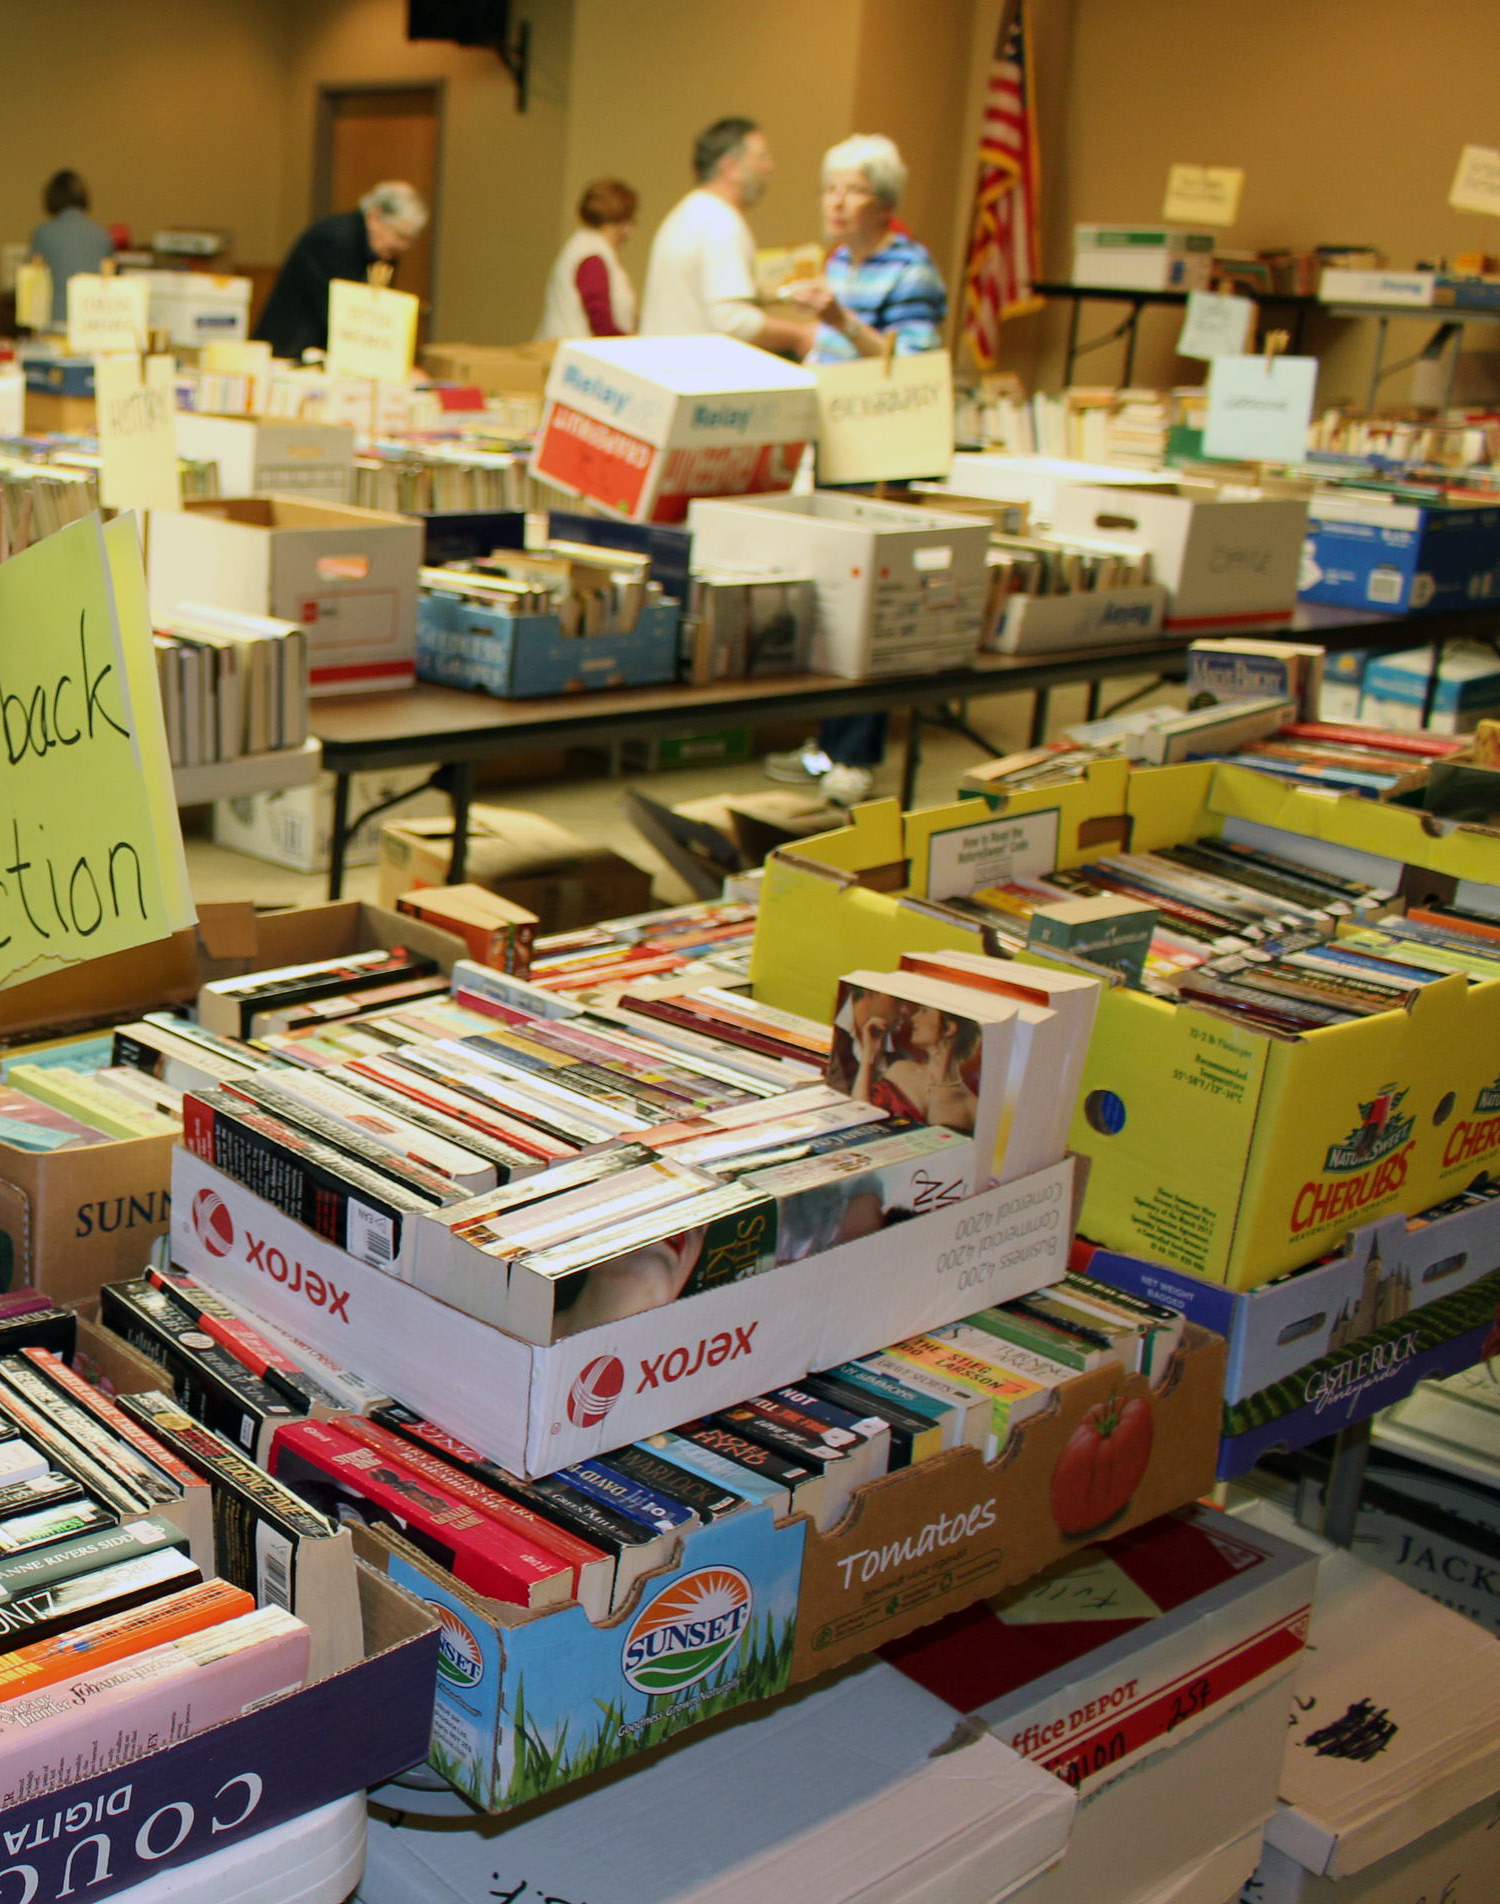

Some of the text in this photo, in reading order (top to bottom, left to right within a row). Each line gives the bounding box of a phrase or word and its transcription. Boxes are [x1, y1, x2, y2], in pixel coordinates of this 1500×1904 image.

[995, 1181, 1063, 1221] Comercial
[1290, 1140, 1417, 1234] CHERUBS
[936, 1208, 1060, 1274] Commercial 4200
[955, 1212, 994, 1242] 4200
[244, 1231, 350, 1325] xerox
[957, 1235, 1058, 1293] Business 4200
[1140, 1274, 1159, 1290] NET
[1159, 1279, 1196, 1302] WEIGHT
[1146, 1288, 1186, 1311] BAGGED
[200, 1351, 266, 1402] DEADLY SIN
[635, 1320, 759, 1395] xerox
[877, 1359, 953, 1393] GRAVE SECRETS
[913, 1338, 991, 1376] THE STIEG
[935, 1359, 1004, 1391] LARSSON
[1304, 1329, 1422, 1403] CASTLE ROCK
[777, 1387, 819, 1407] NOT
[857, 1372, 919, 1402] SIMMONS
[692, 1430, 766, 1467] HYND
[709, 1429, 771, 1458] NOEL
[754, 1418, 808, 1443] LOVE ME
[390, 1436, 538, 1523] MARY HIGGINS CLARK
[400, 1451, 505, 1512] REMEMBER ME
[578, 1468, 629, 1497] DAVID
[619, 1450, 717, 1501] WARLOCK
[44, 1542, 99, 1568] RIVERS
[836, 1498, 997, 1590] Tomatoes
[624, 1602, 749, 1673] SUNSET
[71, 1669, 133, 1706] Johanna
[1067, 1678, 1140, 1733] DEPOT
[11, 1698, 72, 1730] Thunder
[617, 1696, 700, 1739] Goodness Grown
